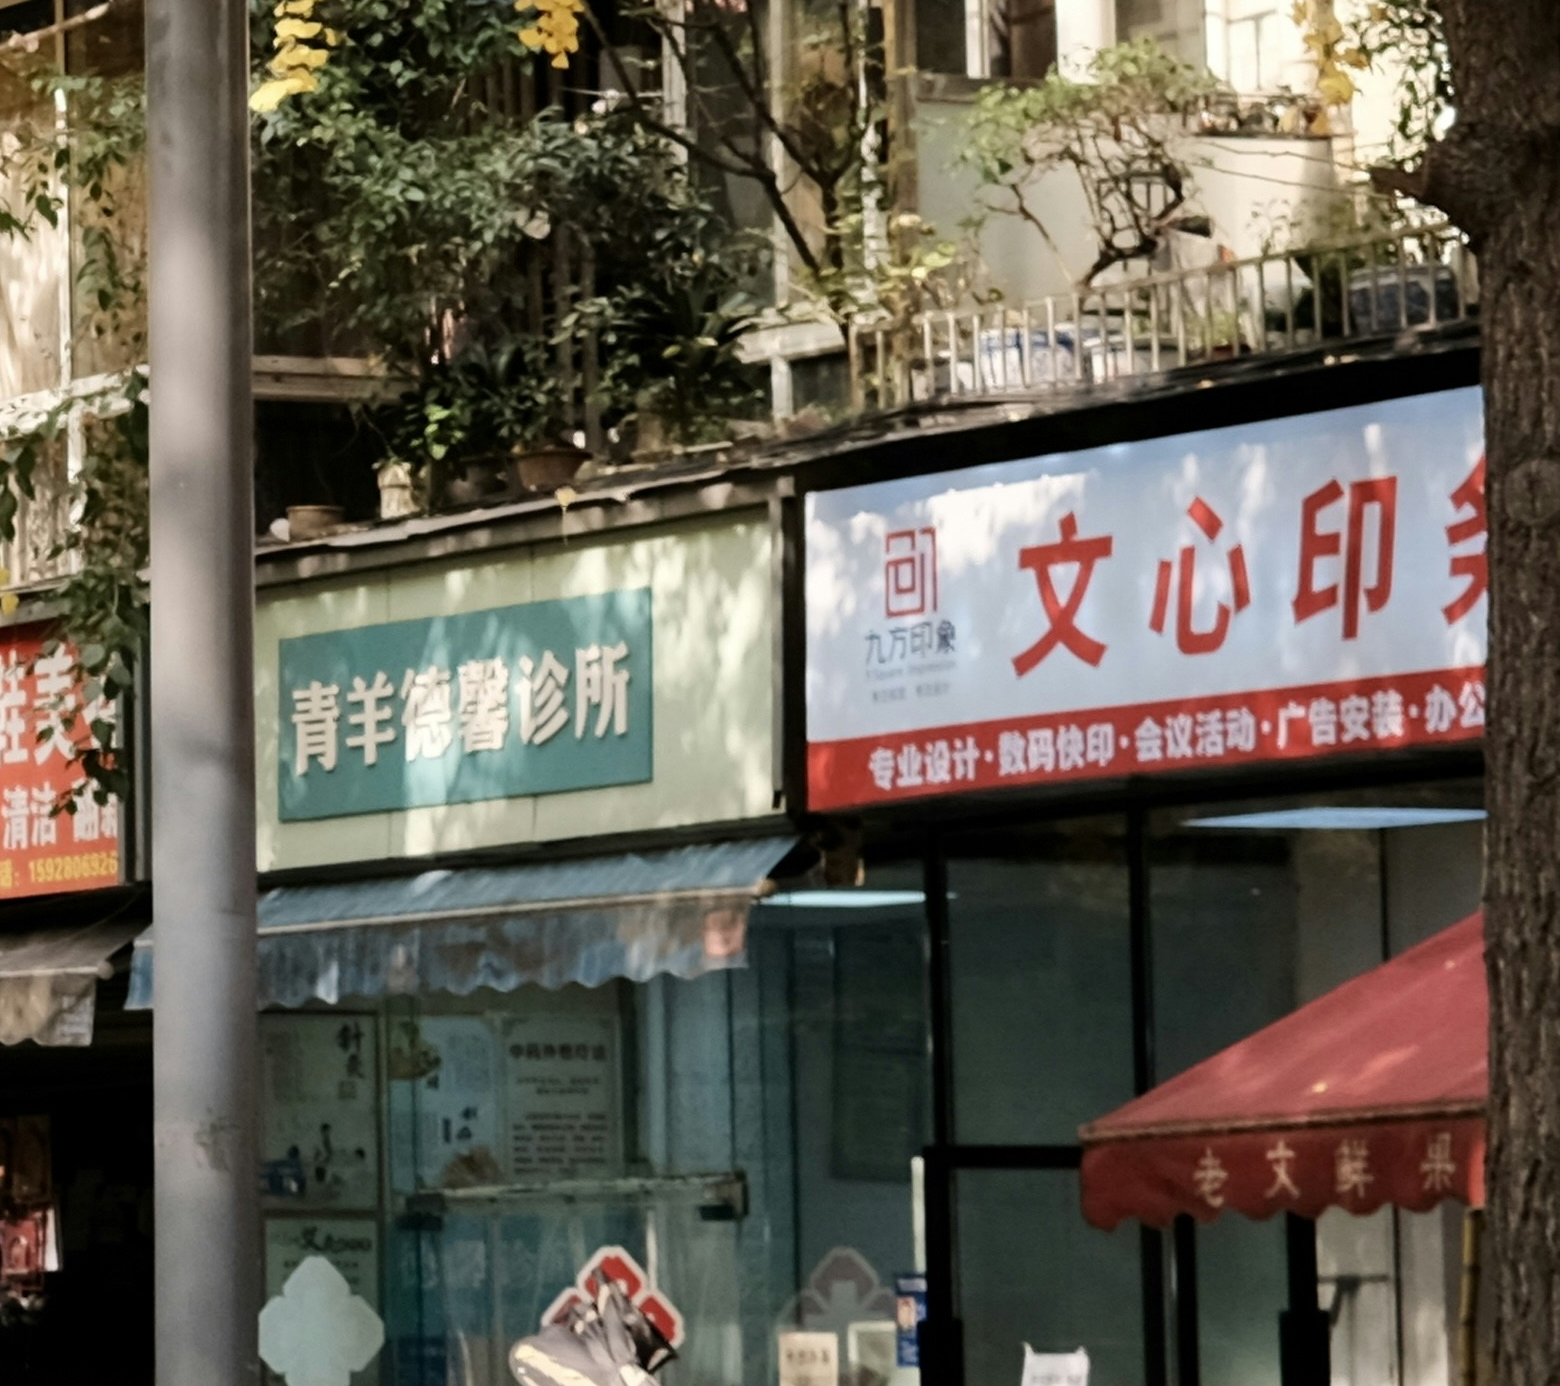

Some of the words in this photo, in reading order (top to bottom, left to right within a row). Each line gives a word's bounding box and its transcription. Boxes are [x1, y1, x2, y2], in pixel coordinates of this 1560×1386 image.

[865, 619, 956, 664] 九方印象
[292, 642, 631, 777] 青羊德馨诊所
[1, 780, 57, 851] 清洁
